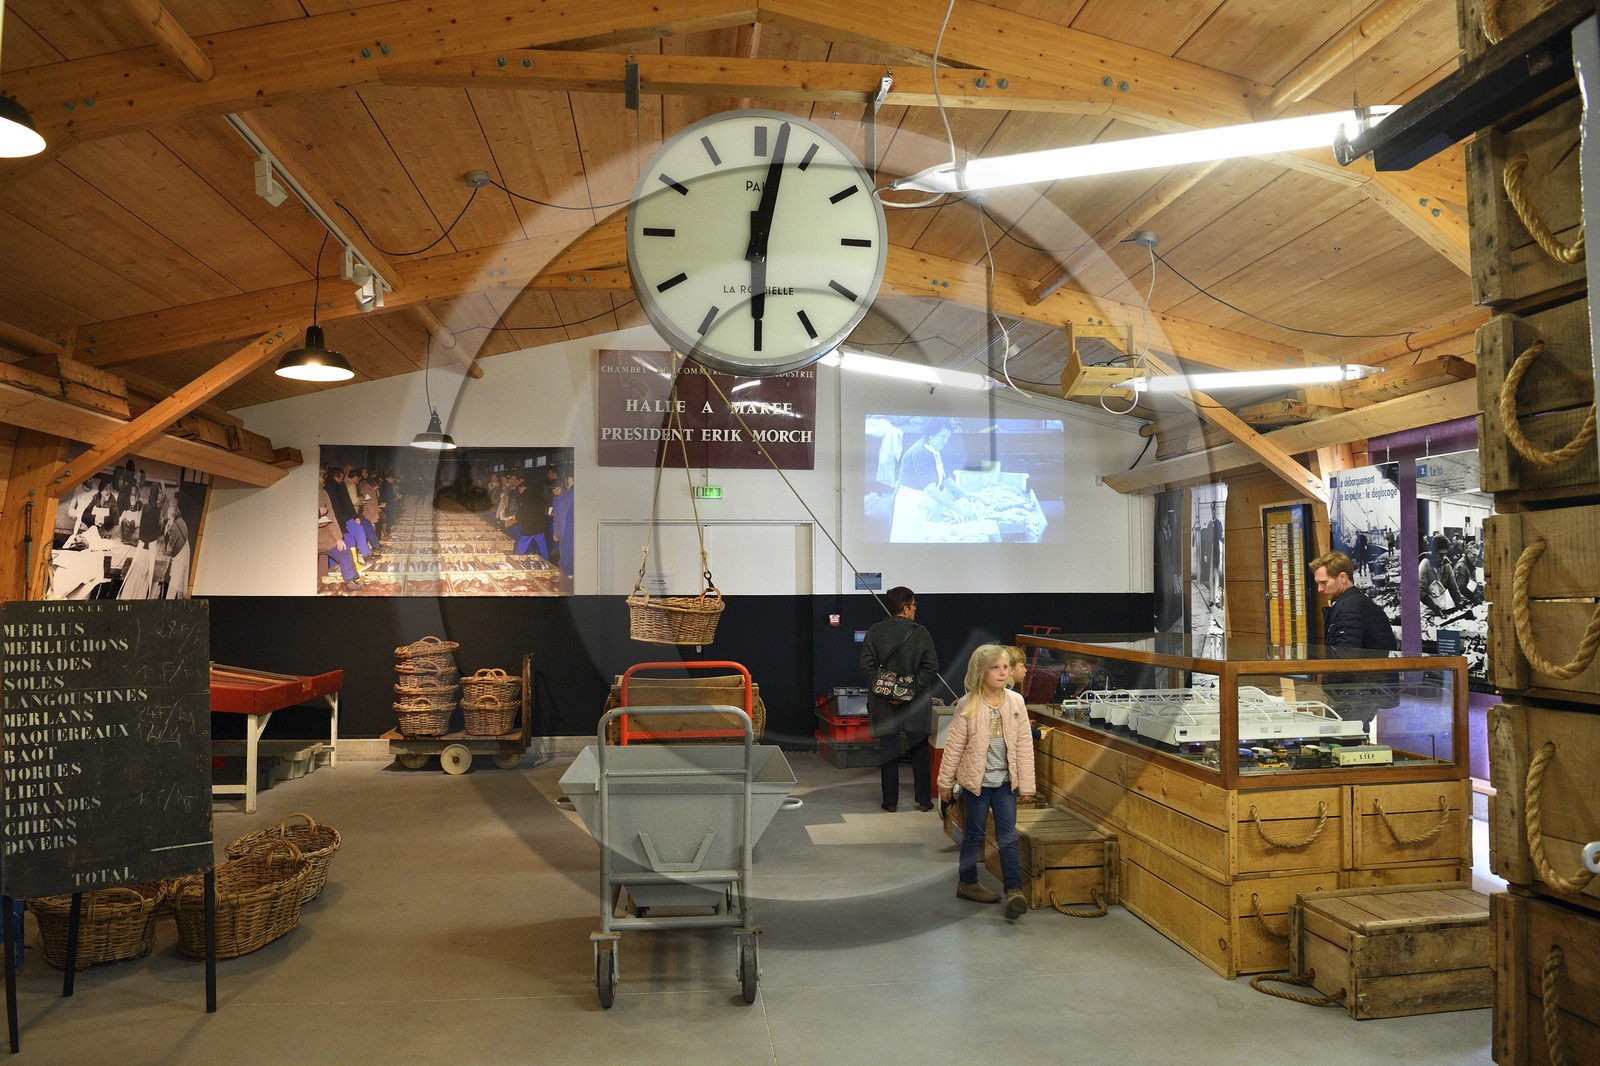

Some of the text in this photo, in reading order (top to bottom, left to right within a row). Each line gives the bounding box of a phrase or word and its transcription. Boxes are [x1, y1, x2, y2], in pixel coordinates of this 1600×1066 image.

[723, 285, 736, 294] LA
[601, 365, 648, 374] CHAMBRE
[626, 399, 793, 415] HALLE A MAREE
[601, 427, 813, 443] PRESIDENT ERIK MORCH
[1344, 475, 1375, 487] débarquement
[39, 604, 132, 613] JOURNEE DU
[3, 623, 85, 638] MERLUS
[3, 638, 129, 656] MERLUCHONS
[4, 658, 92, 674] DORADES
[4, 676, 65, 691] SOLES
[4, 689, 148, 709] LANGOUSTINES
[3, 710, 94, 728] MERLANS
[4, 723, 130, 746] MAQUEREAUX
[4, 747, 57, 764] BAOT
[4, 763, 82, 782] MORUES
[5, 782, 64, 800] LIEUX
[5, 796, 101, 818] LIMANDES
[4, 816, 77, 837] CHIENS
[5, 834, 77, 855] DIVERS
[72, 866, 137, 887] TOTAL
